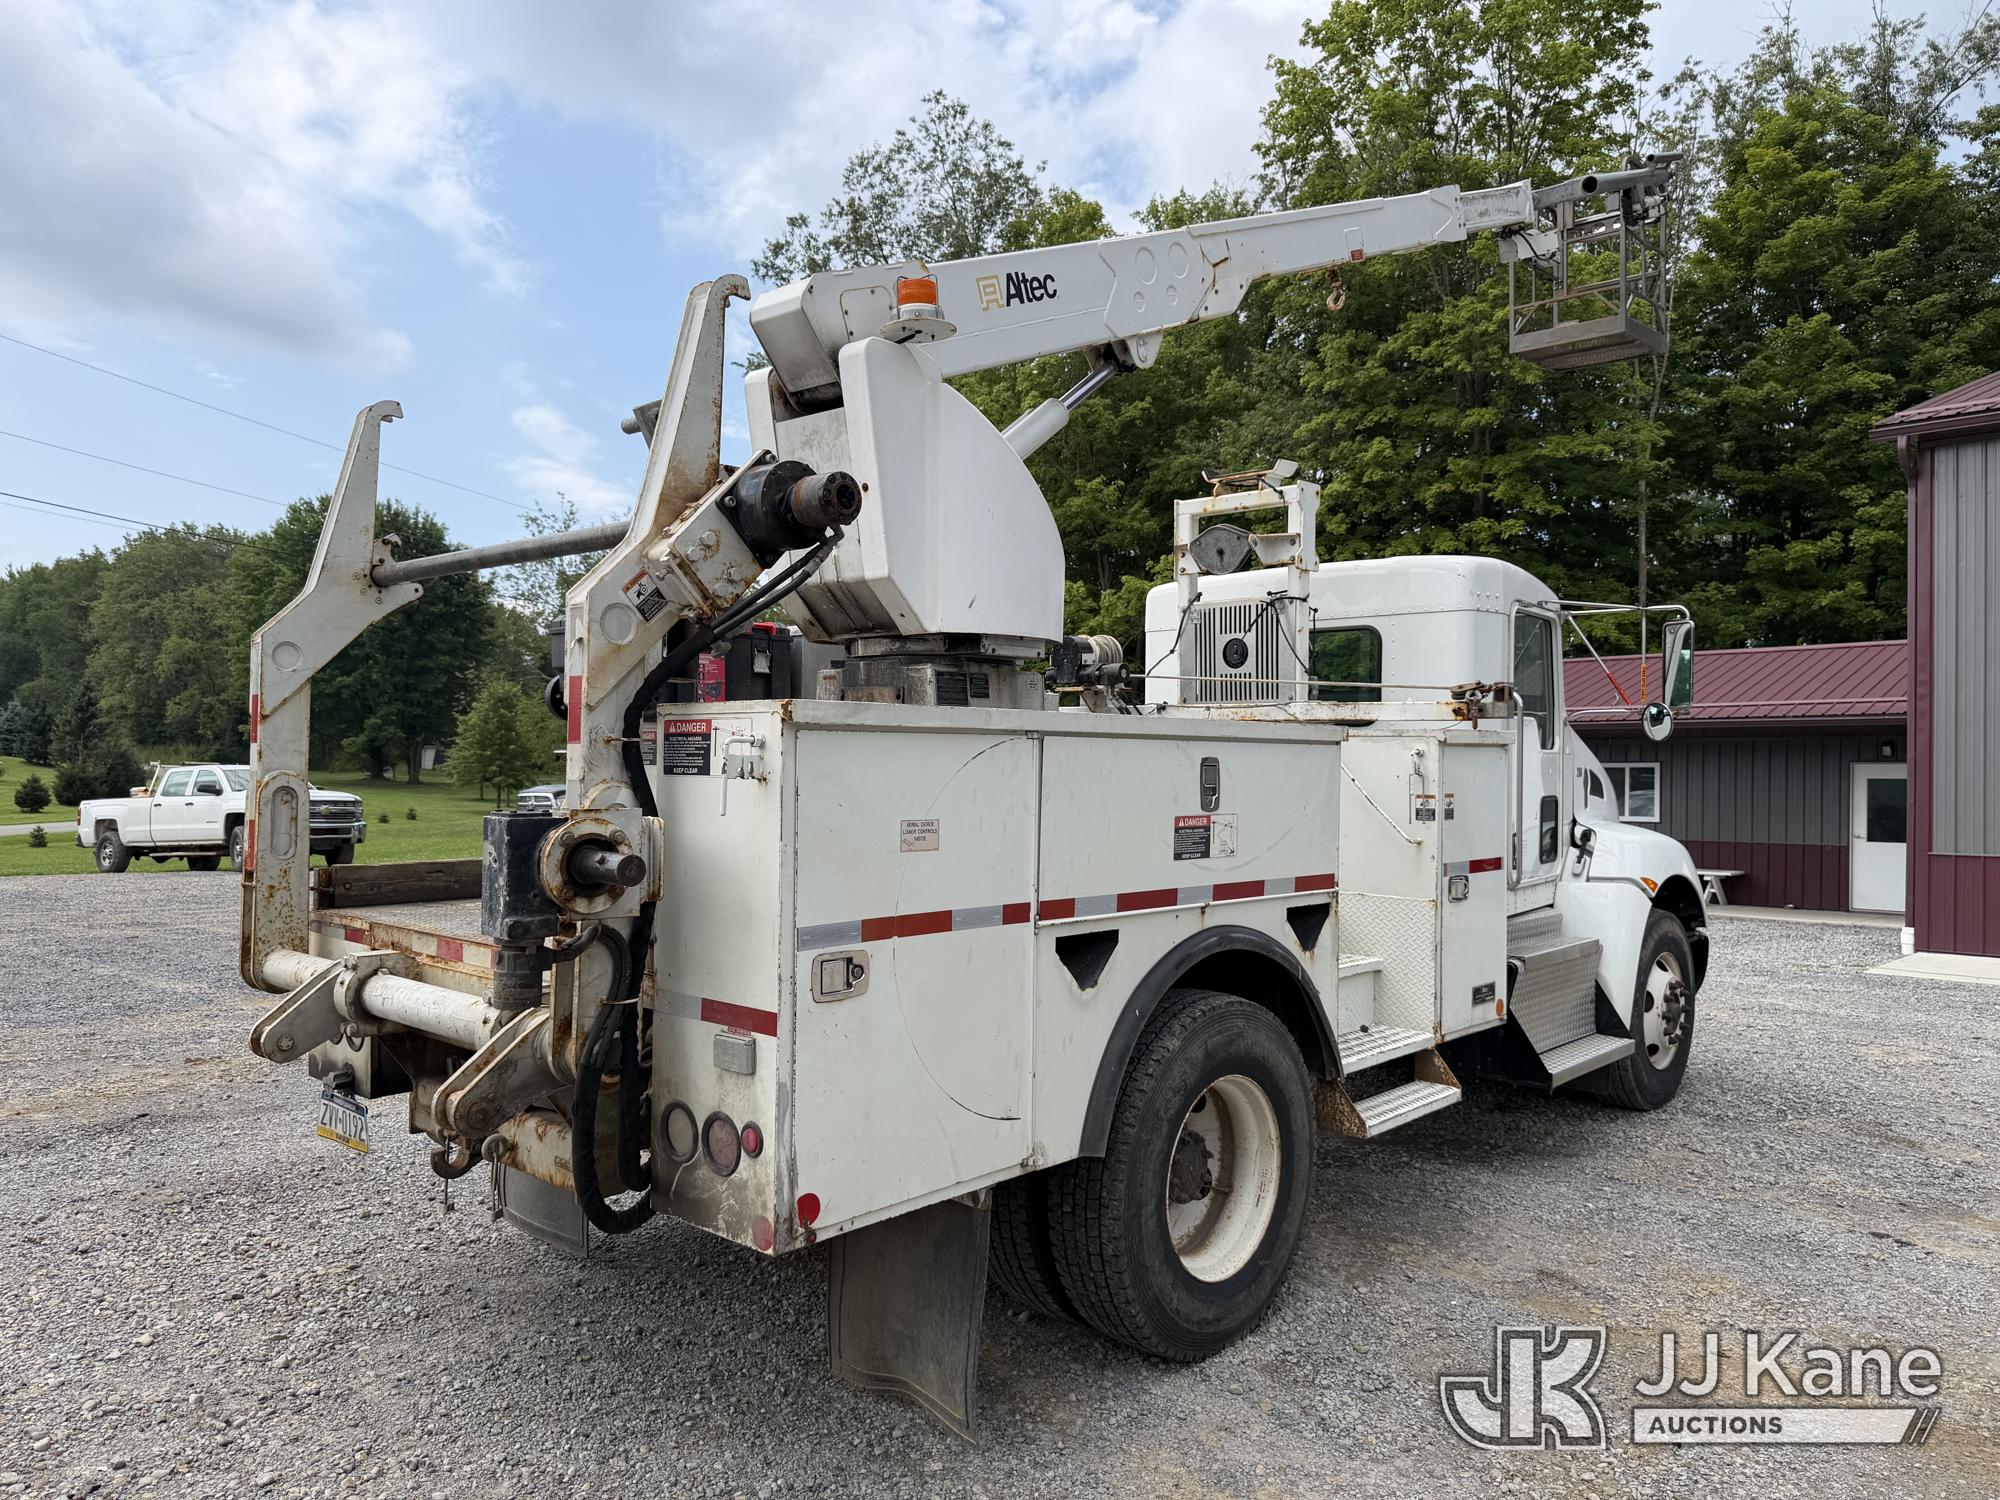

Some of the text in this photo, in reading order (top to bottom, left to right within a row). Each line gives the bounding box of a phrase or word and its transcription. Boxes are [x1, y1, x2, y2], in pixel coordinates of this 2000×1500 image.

[1006, 271, 1058, 307] Altec
[676, 722, 707, 733] DANGER
[1184, 817, 1208, 826] DANGER
